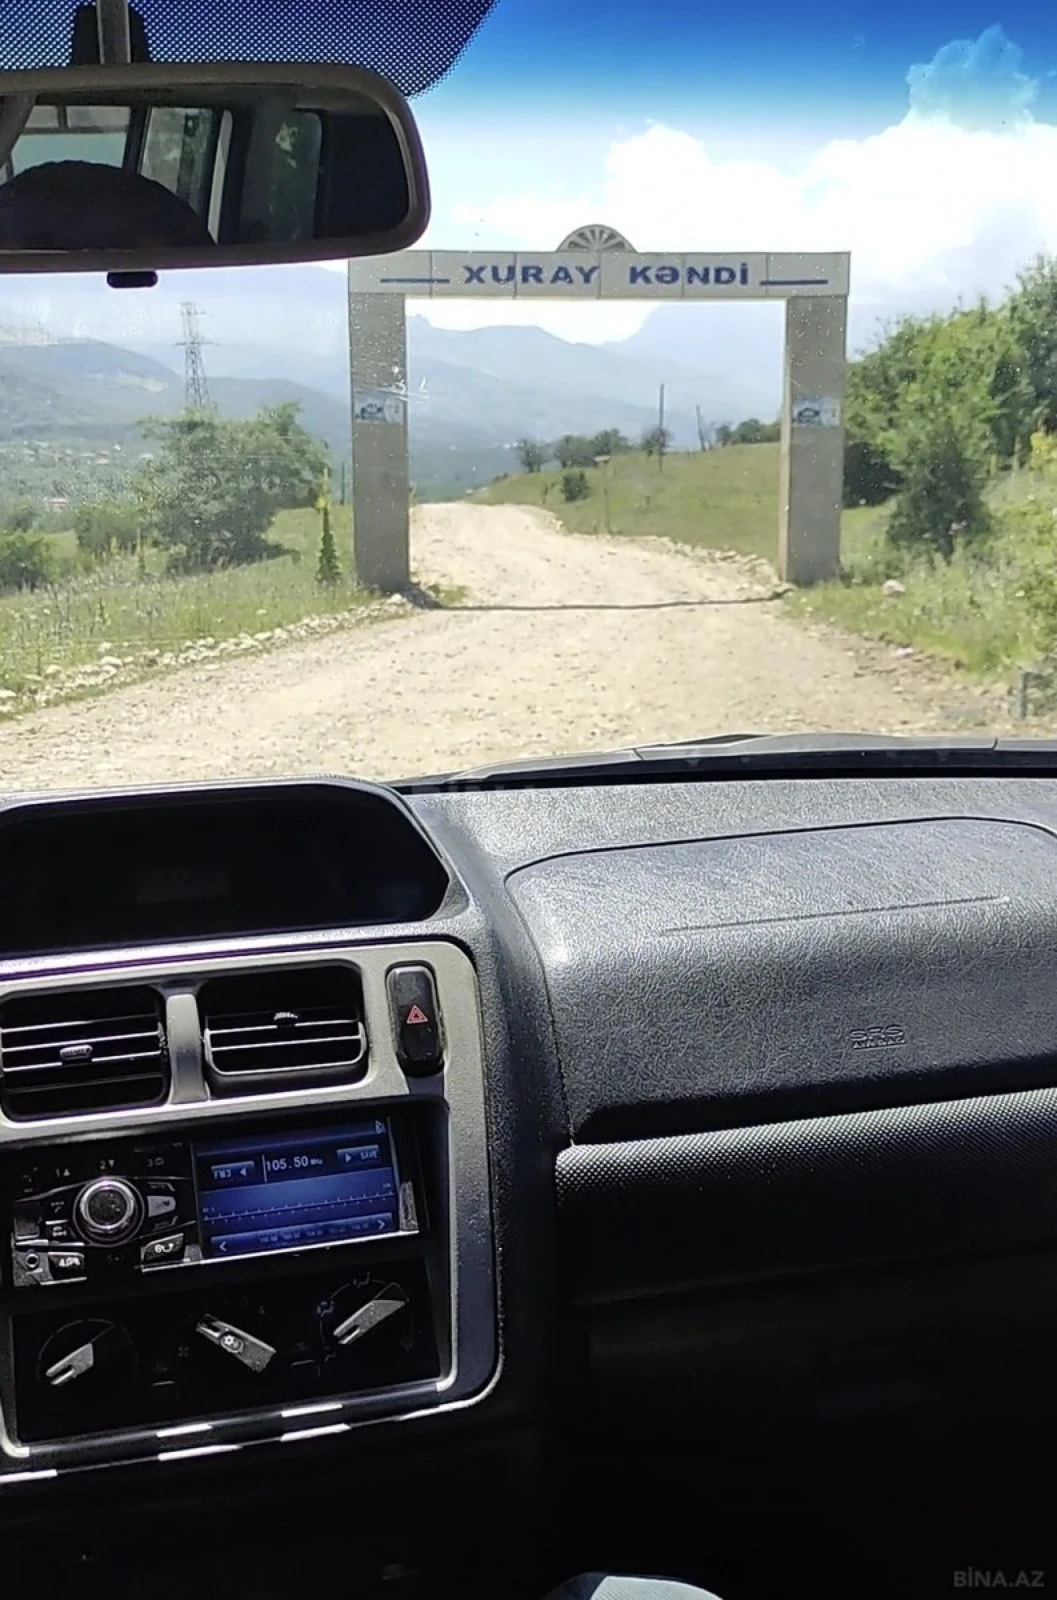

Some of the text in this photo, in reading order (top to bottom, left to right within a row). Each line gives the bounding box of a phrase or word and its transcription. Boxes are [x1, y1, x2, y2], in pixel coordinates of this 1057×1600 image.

[463, 263, 748, 285] XURAY KƏNDİ
[266, 1155, 308, 1171] 105.50
